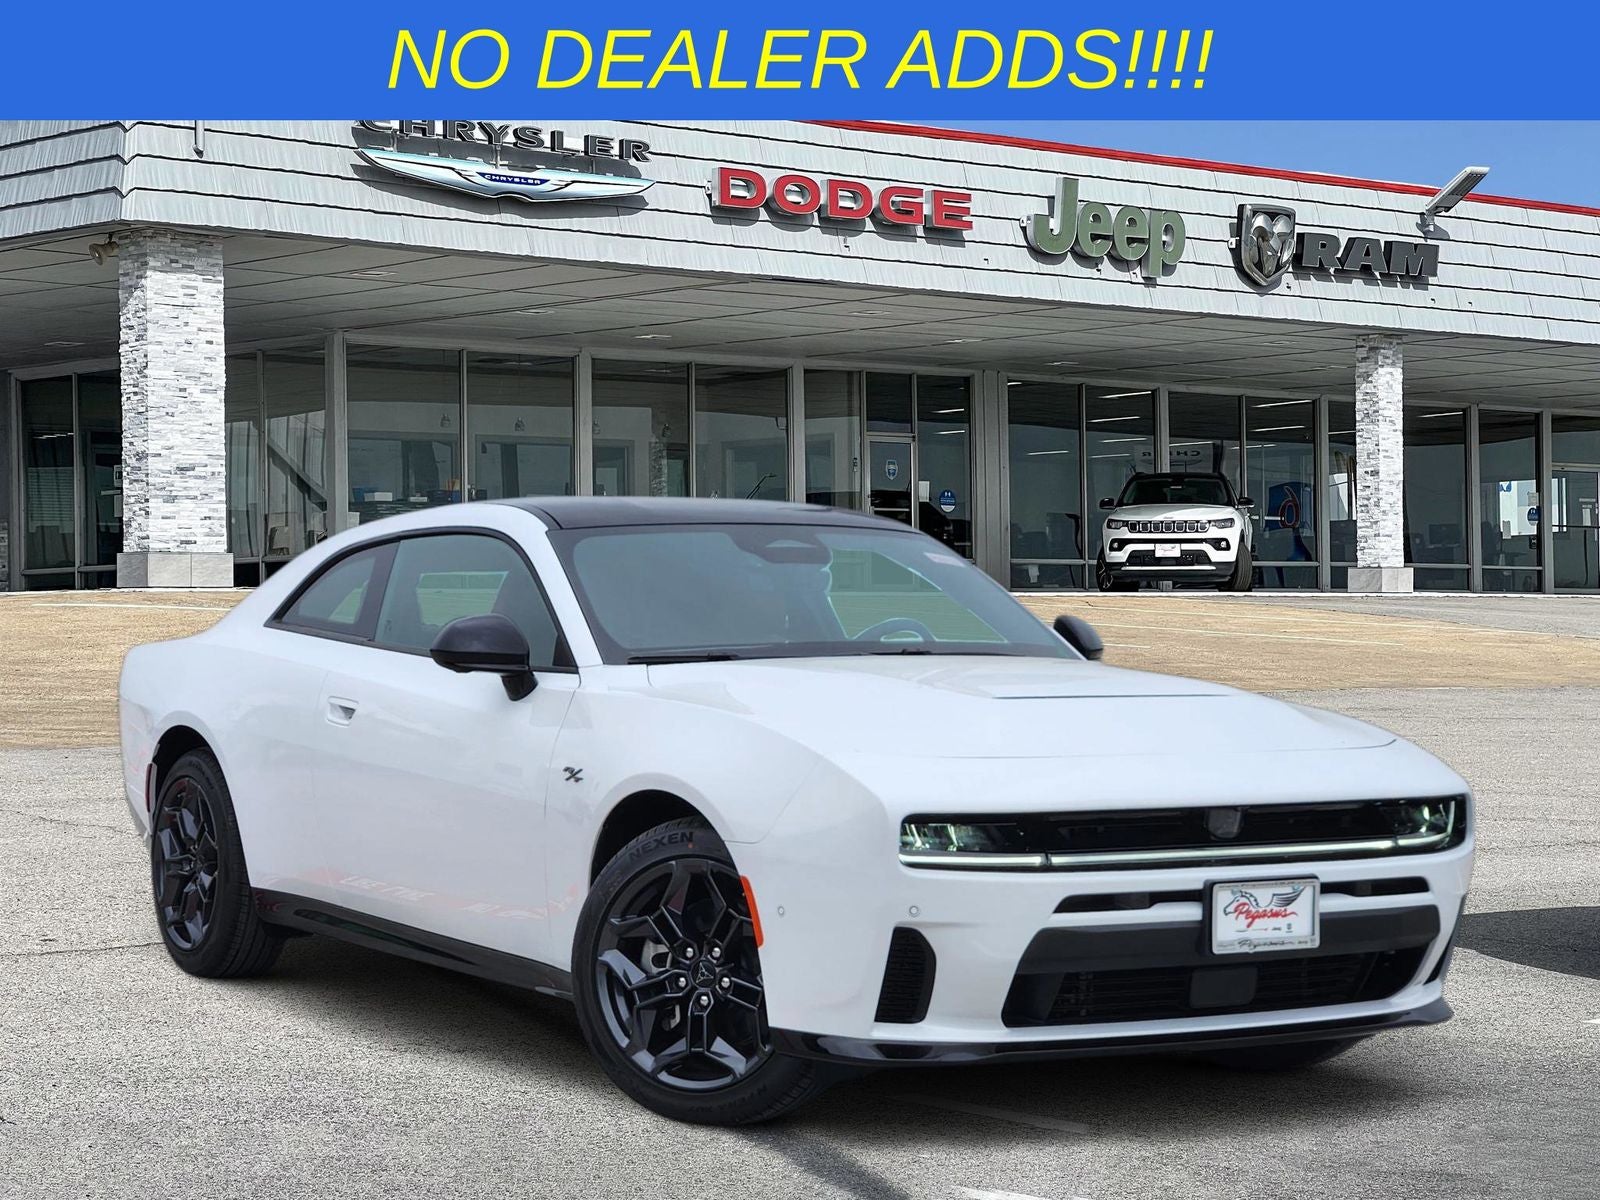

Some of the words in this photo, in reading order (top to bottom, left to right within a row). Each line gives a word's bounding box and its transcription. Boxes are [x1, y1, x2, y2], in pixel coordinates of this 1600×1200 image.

[484, 174, 541, 184] CHRYSLER
[713, 167, 973, 231] DODGE
[1030, 177, 1186, 278] Jeep
[1298, 233, 1440, 277] RAM
[628, 831, 694, 860] NEXEN
[1234, 902, 1298, 928] Pegasus
